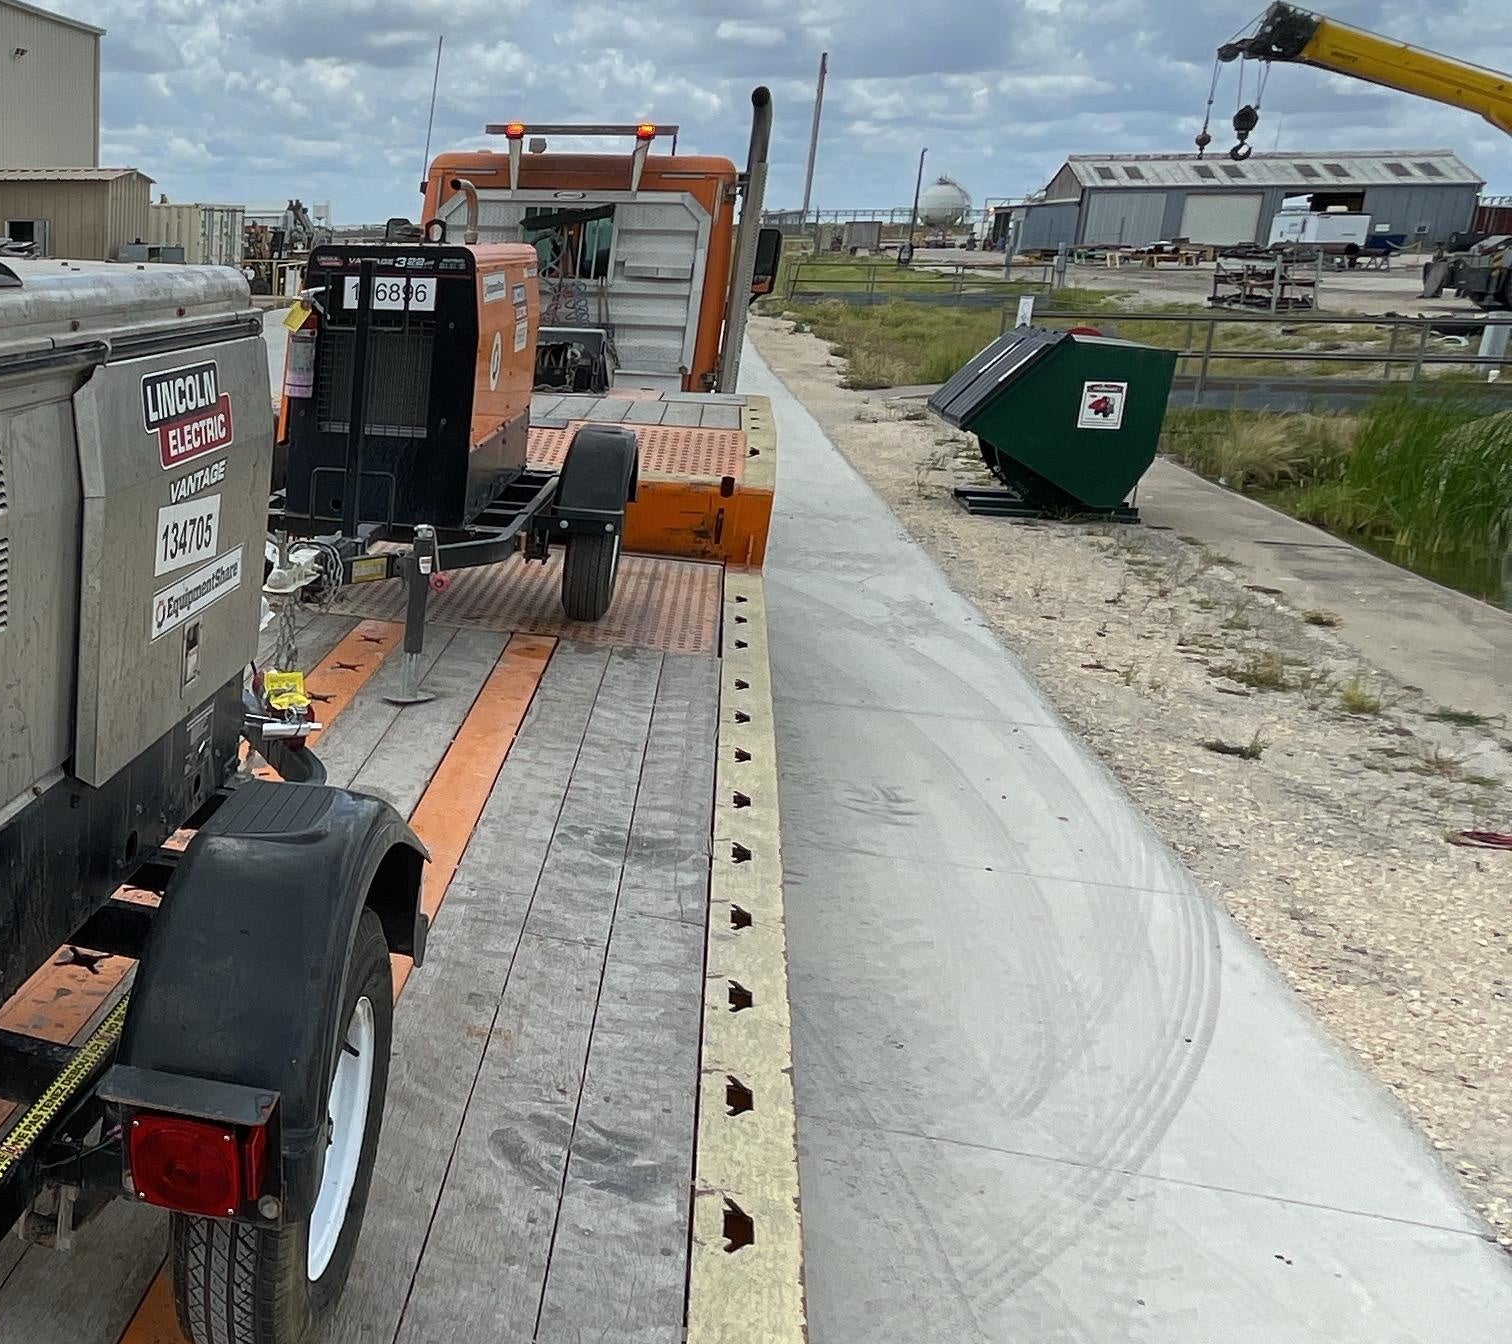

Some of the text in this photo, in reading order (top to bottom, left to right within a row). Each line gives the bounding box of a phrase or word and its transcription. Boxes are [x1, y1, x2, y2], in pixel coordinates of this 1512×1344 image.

[348, 257, 394, 265] VAAGE
[351, 282, 428, 303] 16896
[146, 369, 217, 423] LINCOLN
[167, 413, 227, 458] ELECTRIC
[169, 459, 228, 504] VANTAGE
[162, 513, 214, 562] 134705
[167, 561, 238, 618] EquipmentShare
[22, 1113, 44, 1135] PAS
